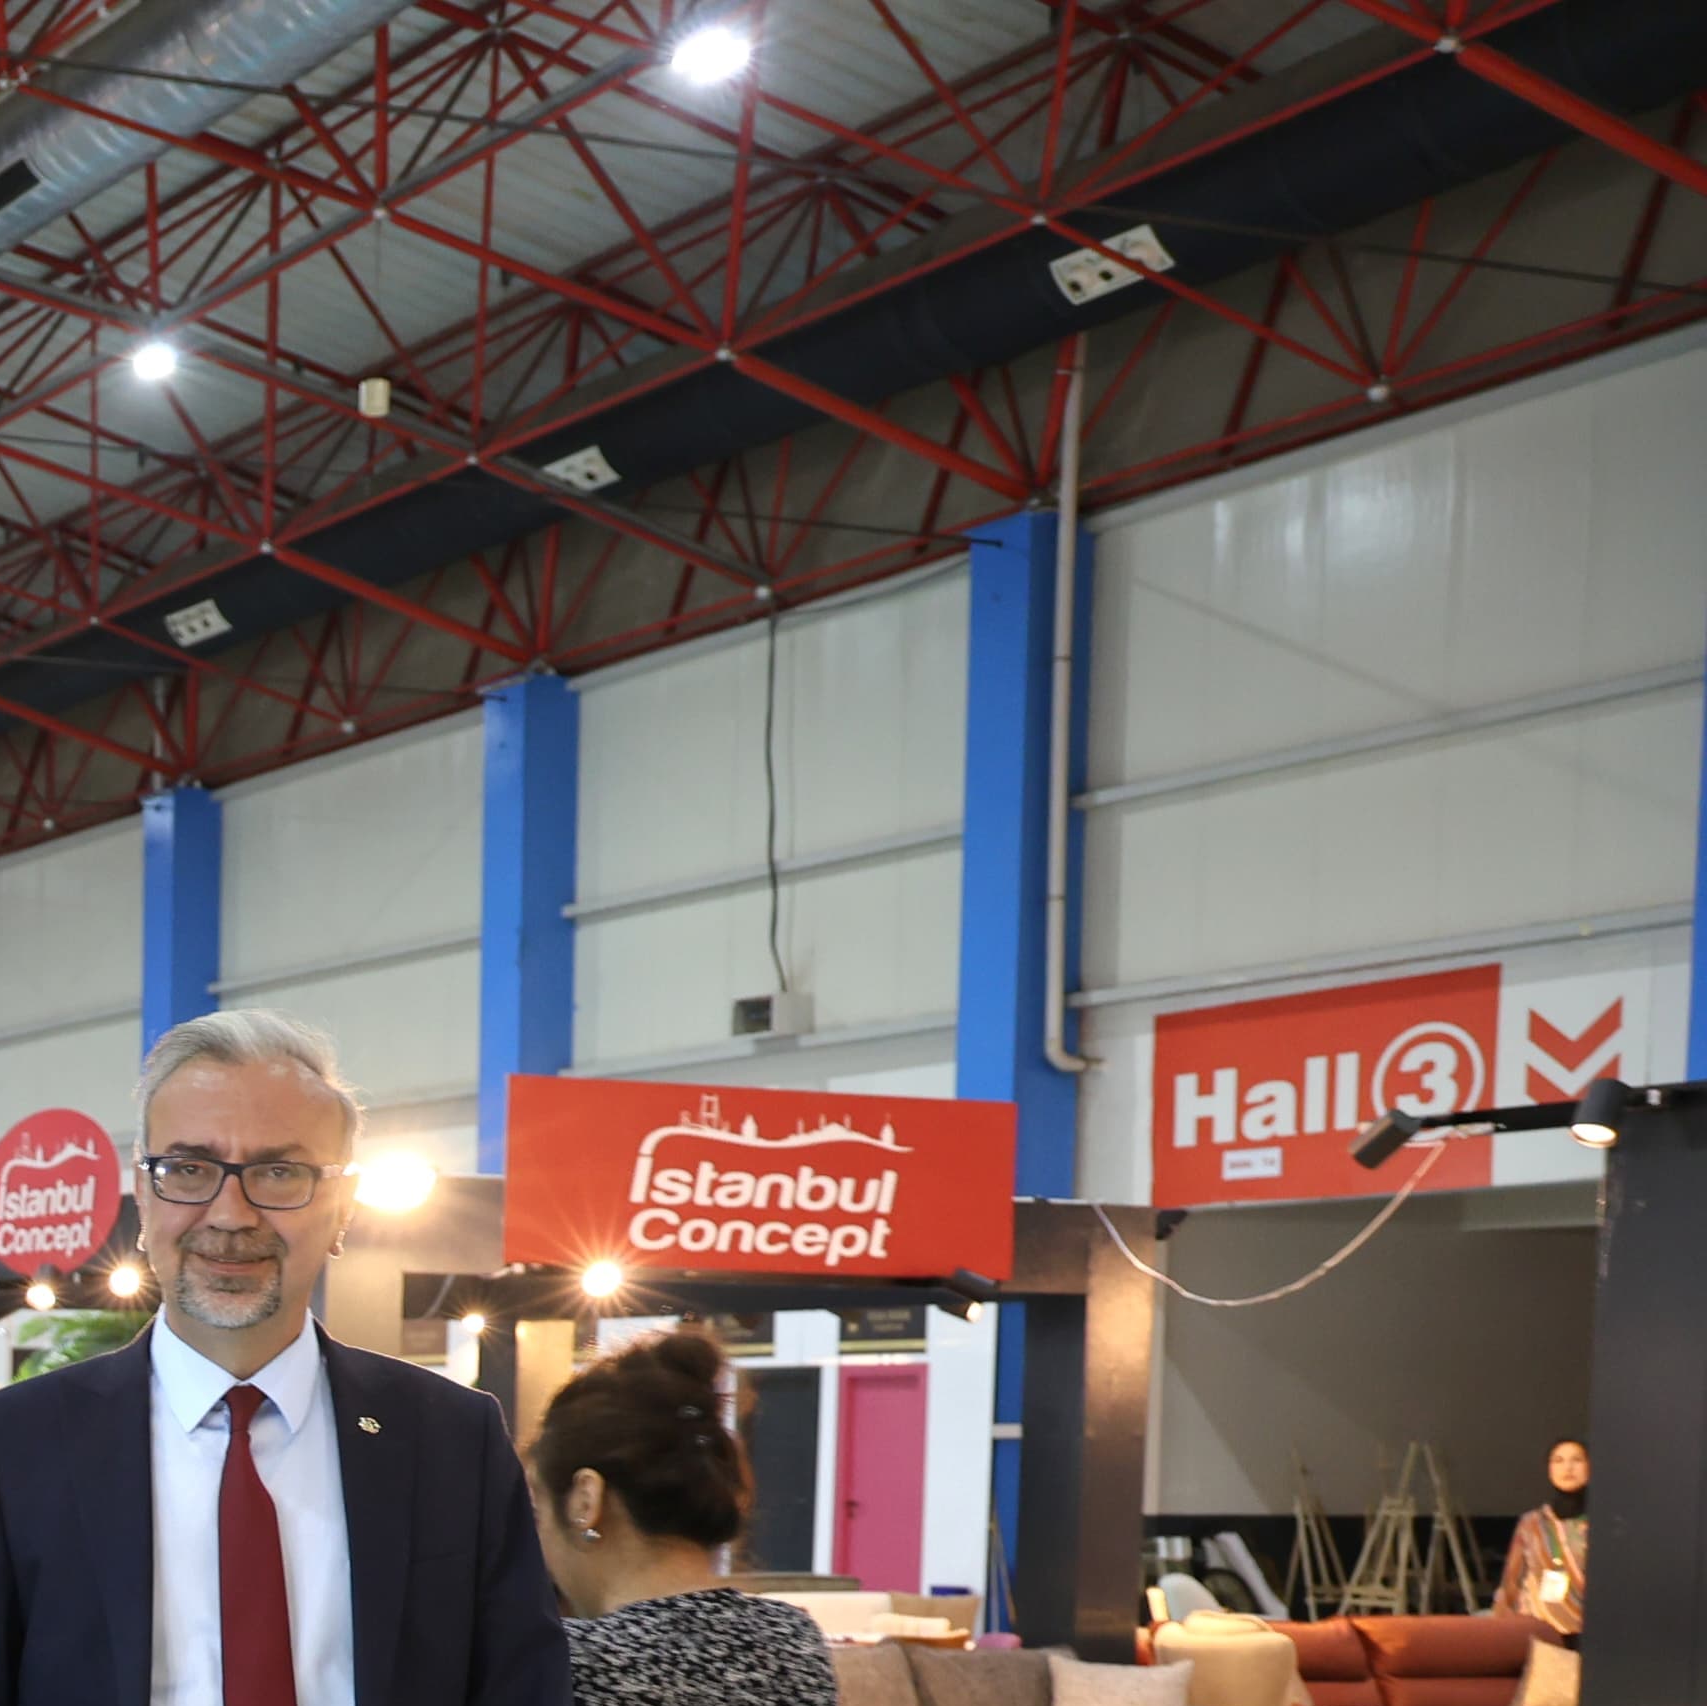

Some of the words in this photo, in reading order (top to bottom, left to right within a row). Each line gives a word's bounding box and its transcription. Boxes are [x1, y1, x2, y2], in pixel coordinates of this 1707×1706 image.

[1173, 1052, 1360, 1149] Hall
[1395, 1041, 1459, 1122] 3
[628, 1207, 893, 1267] Concept
